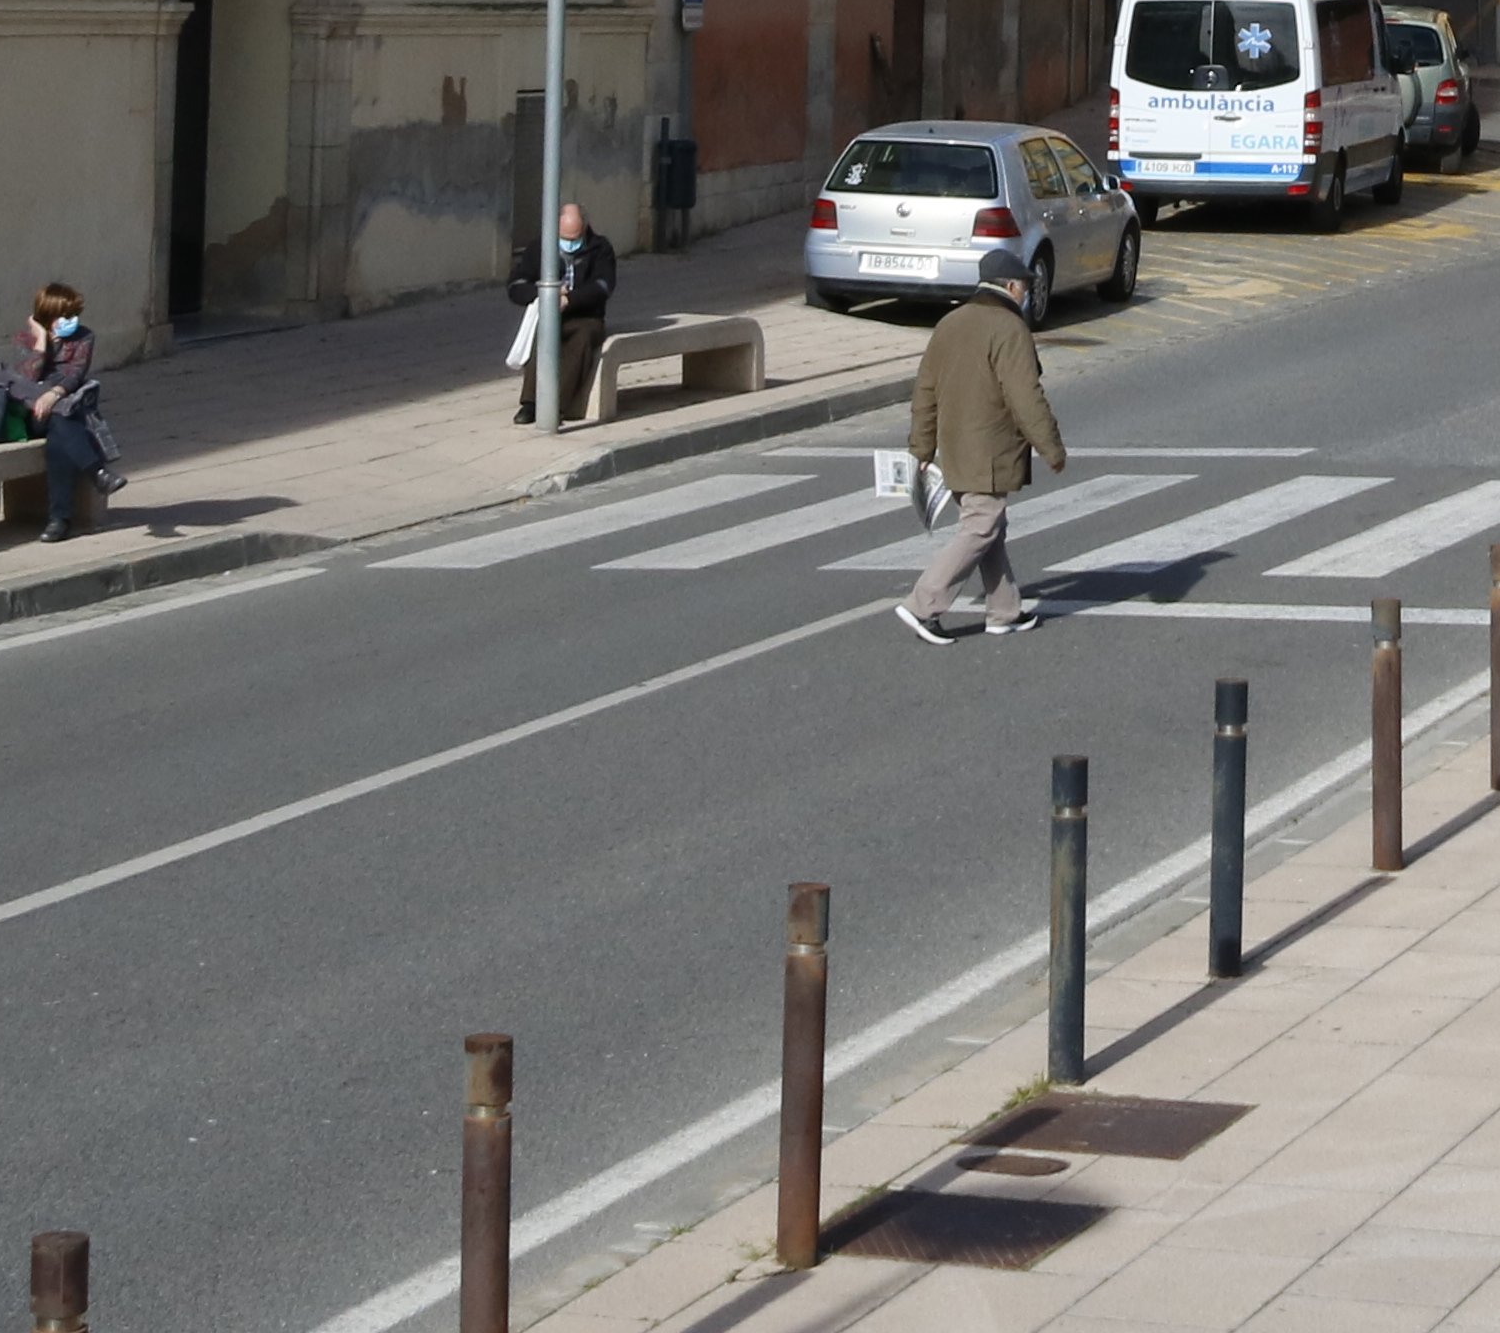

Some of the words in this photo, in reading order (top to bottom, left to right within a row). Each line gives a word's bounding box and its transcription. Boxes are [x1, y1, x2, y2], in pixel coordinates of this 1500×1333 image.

[1148, 93, 1275, 113] ambulància
[1230, 134, 1299, 150] EGARA
[1143, 160, 1169, 173] 4109
[1271, 164, 1299, 175] A-112
